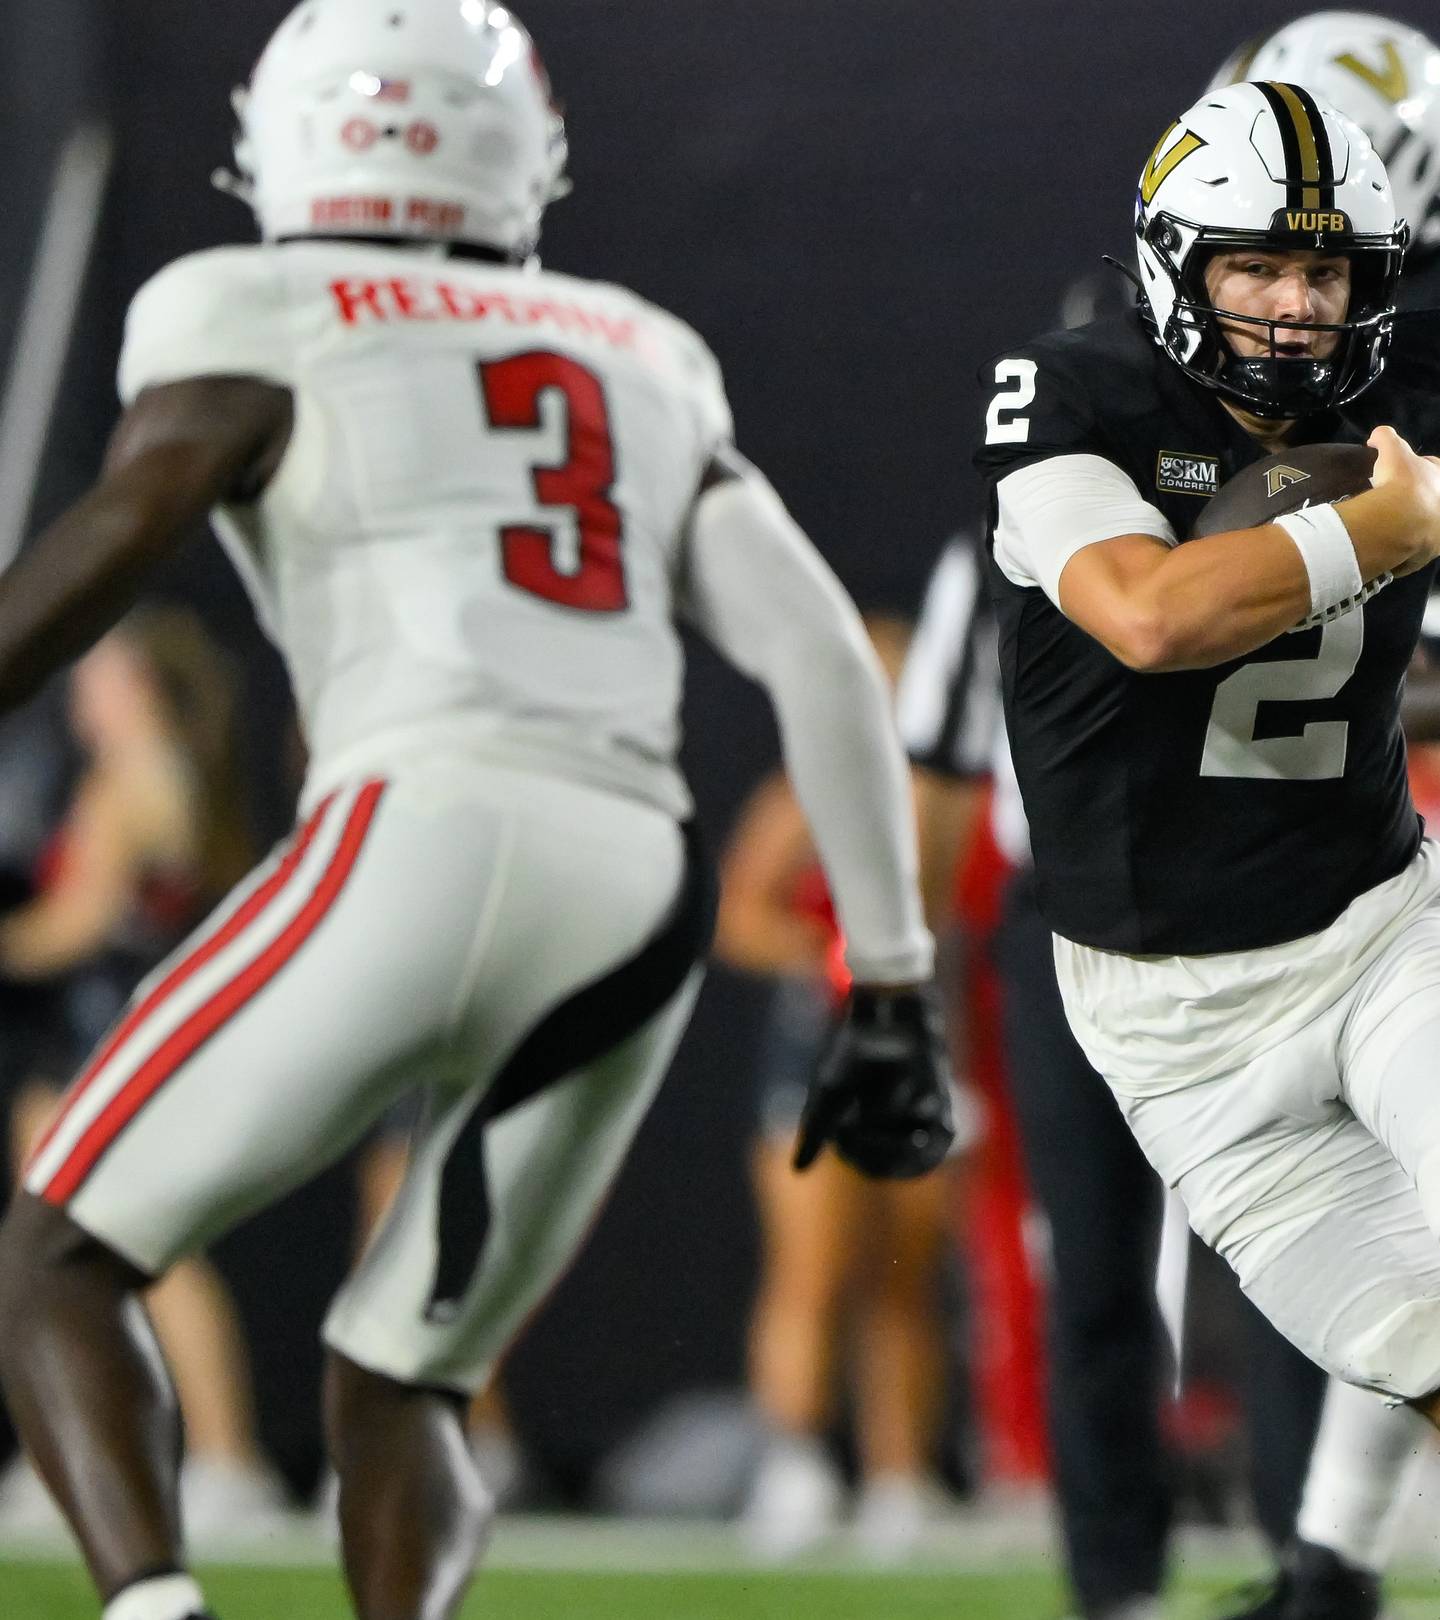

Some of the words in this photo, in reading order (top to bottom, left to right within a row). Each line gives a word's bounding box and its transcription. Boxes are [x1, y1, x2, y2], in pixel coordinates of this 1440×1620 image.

[1286, 212, 1345, 232] VUFB
[985, 358, 1038, 445] 2
[477, 350, 631, 616] 3
[1159, 478, 1217, 493] CONCRETE
[1171, 458, 1218, 483] SRM
[1199, 602, 1364, 781] 2
